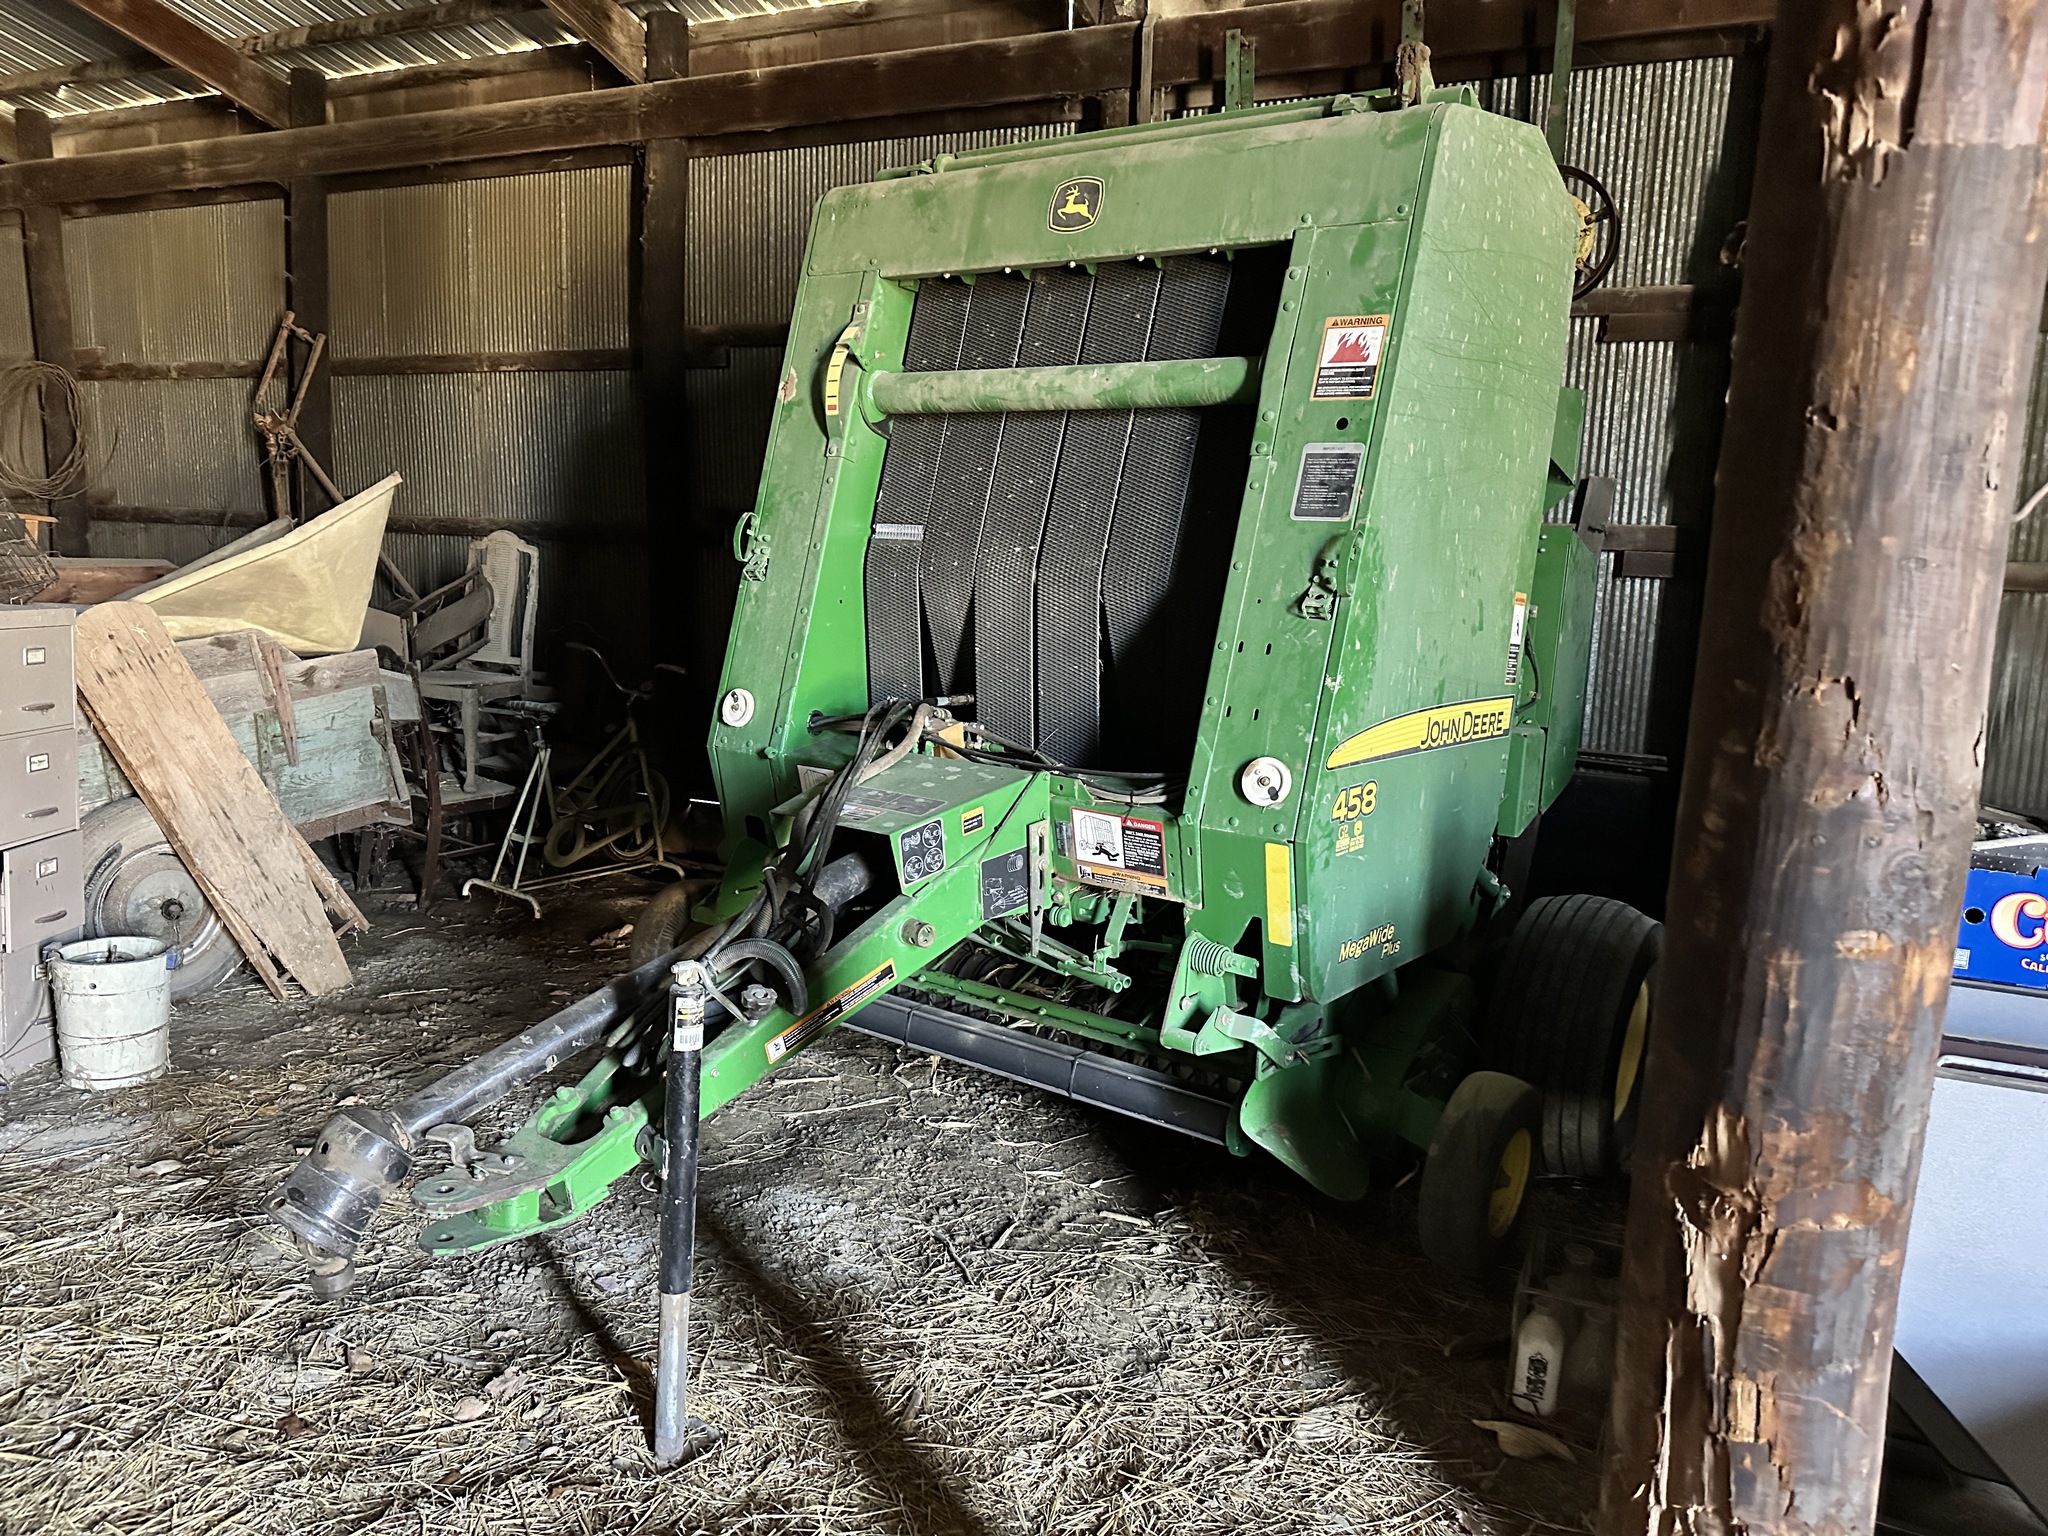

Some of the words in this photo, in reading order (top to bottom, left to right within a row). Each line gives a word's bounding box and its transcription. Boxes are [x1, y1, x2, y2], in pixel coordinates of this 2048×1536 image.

[1340, 317, 1383, 325] WARNING
[1421, 717, 1461, 745] JOHN
[1462, 711, 1504, 737] DEERE
[1331, 779, 1378, 824] 458
[1133, 822, 1157, 830] DANGER
[1991, 892, 2048, 950] C
[1338, 922, 1395, 963] MegaWide
[1380, 940, 1401, 960] Plus
